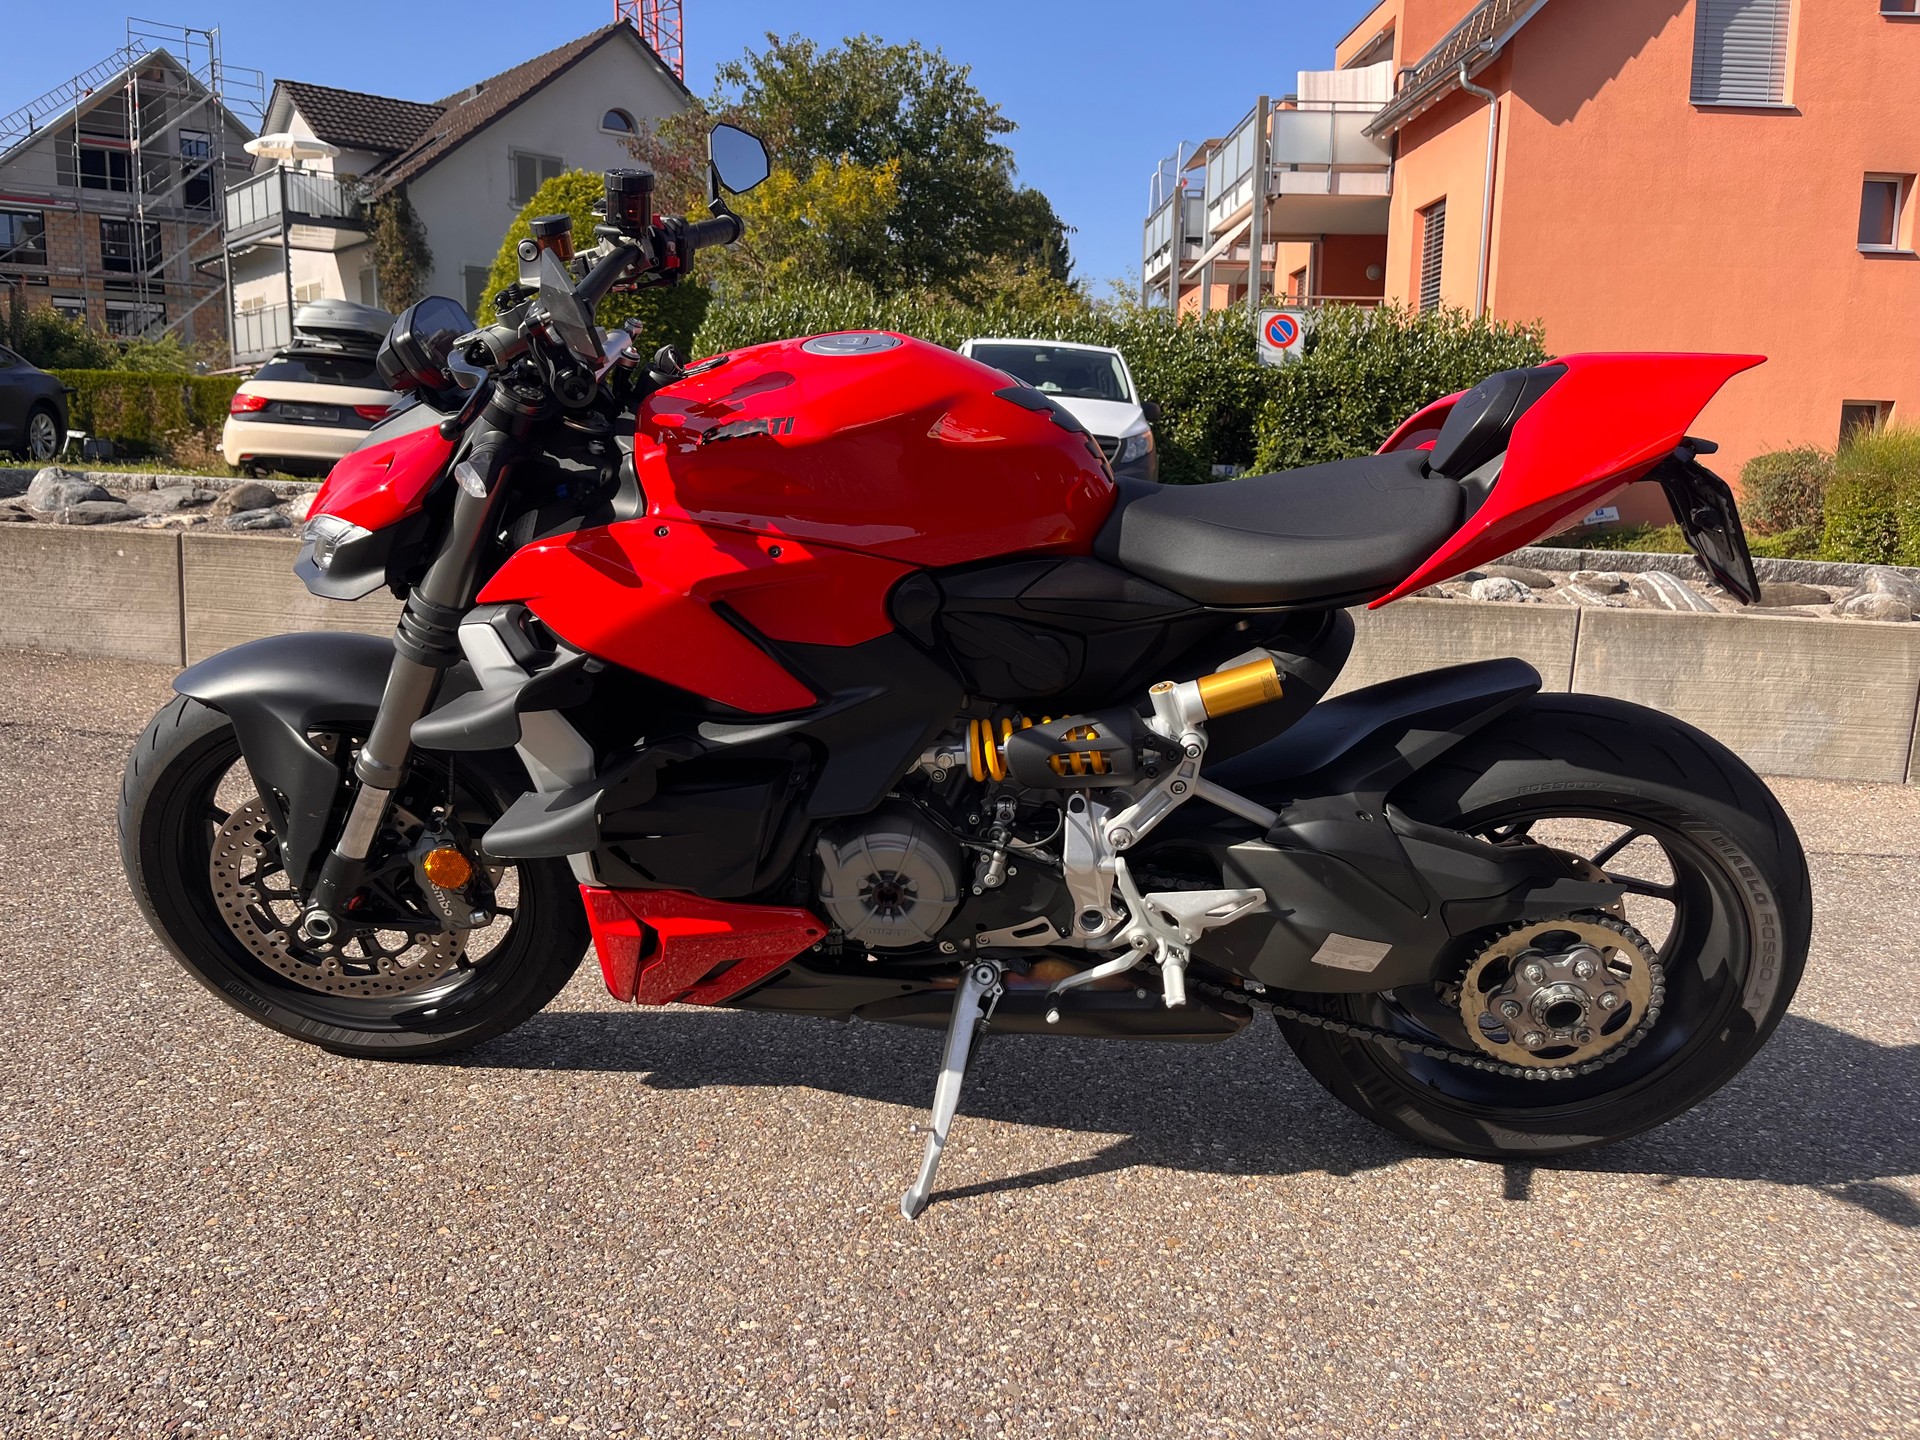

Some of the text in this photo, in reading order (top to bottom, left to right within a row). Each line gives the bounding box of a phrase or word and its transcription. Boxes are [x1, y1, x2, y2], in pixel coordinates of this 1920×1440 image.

[428, 880, 453, 917] embo
[1711, 836, 1770, 906] DIABLO
[1759, 913, 1777, 981] ROSSO
